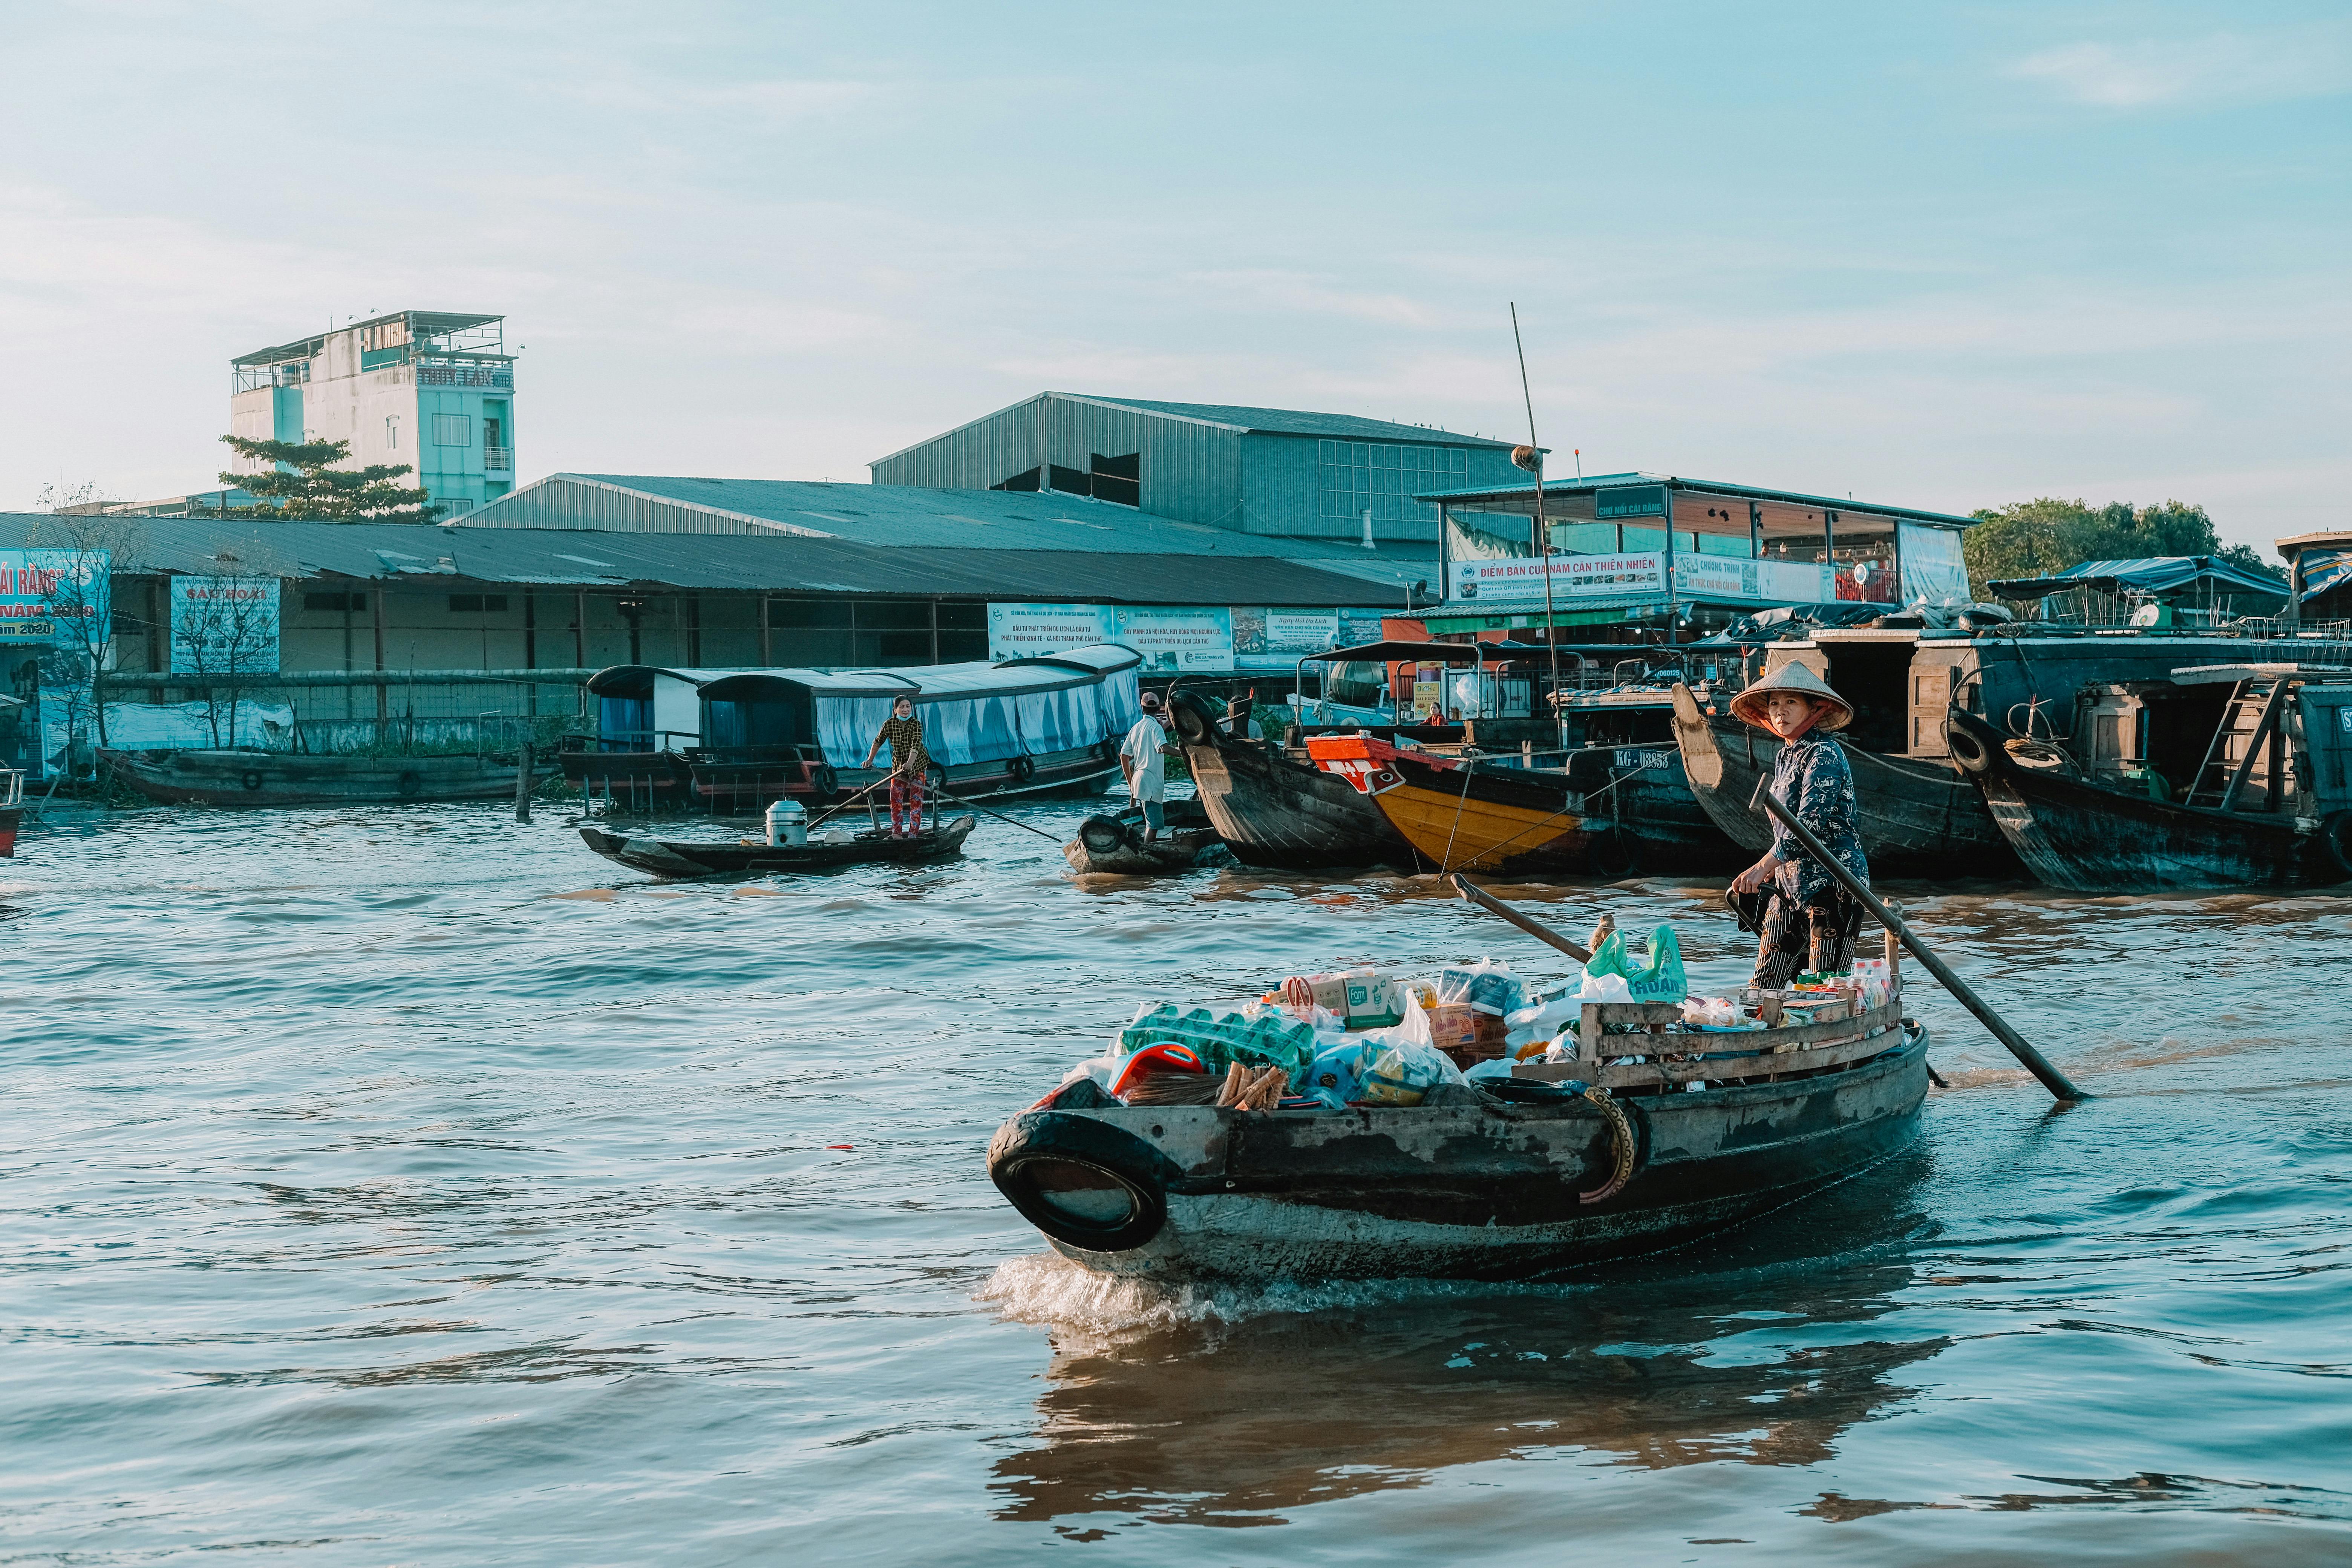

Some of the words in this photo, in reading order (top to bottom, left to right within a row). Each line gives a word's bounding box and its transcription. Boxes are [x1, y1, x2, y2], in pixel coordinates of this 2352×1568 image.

[463, 369, 492, 386] LAN
[1599, 506, 1613, 516] CHỢ
[1615, 502, 1626, 514] NỔI
[1629, 503, 1640, 513] CÁI
[1643, 502, 1661, 512] RĂNG
[1481, 563, 1504, 577] ĐIỂM
[1507, 564, 1525, 576] BÁN
[1529, 565, 1546, 575] CUA
[1550, 562, 1570, 574] NĂM
[1573, 561, 1591, 573] CĂN
[1595, 559, 1623, 571] THIÊN
[1627, 557, 1655, 570] NHIÊN
[1700, 559, 1722, 572] CHƯƠNG
[1724, 561, 1740, 573] TRÌNH
[1695, 577, 1705, 590] THỰC
[1730, 580, 1740, 592] RĂNG
[1013, 633, 1025, 641] TRIỂN
[1615, 751, 1631, 766] KG
[1640, 751, 1668, 769] 03853
[1435, 1018, 1446, 1033] Hảo
[1447, 1015, 1457, 1029] Hảo
